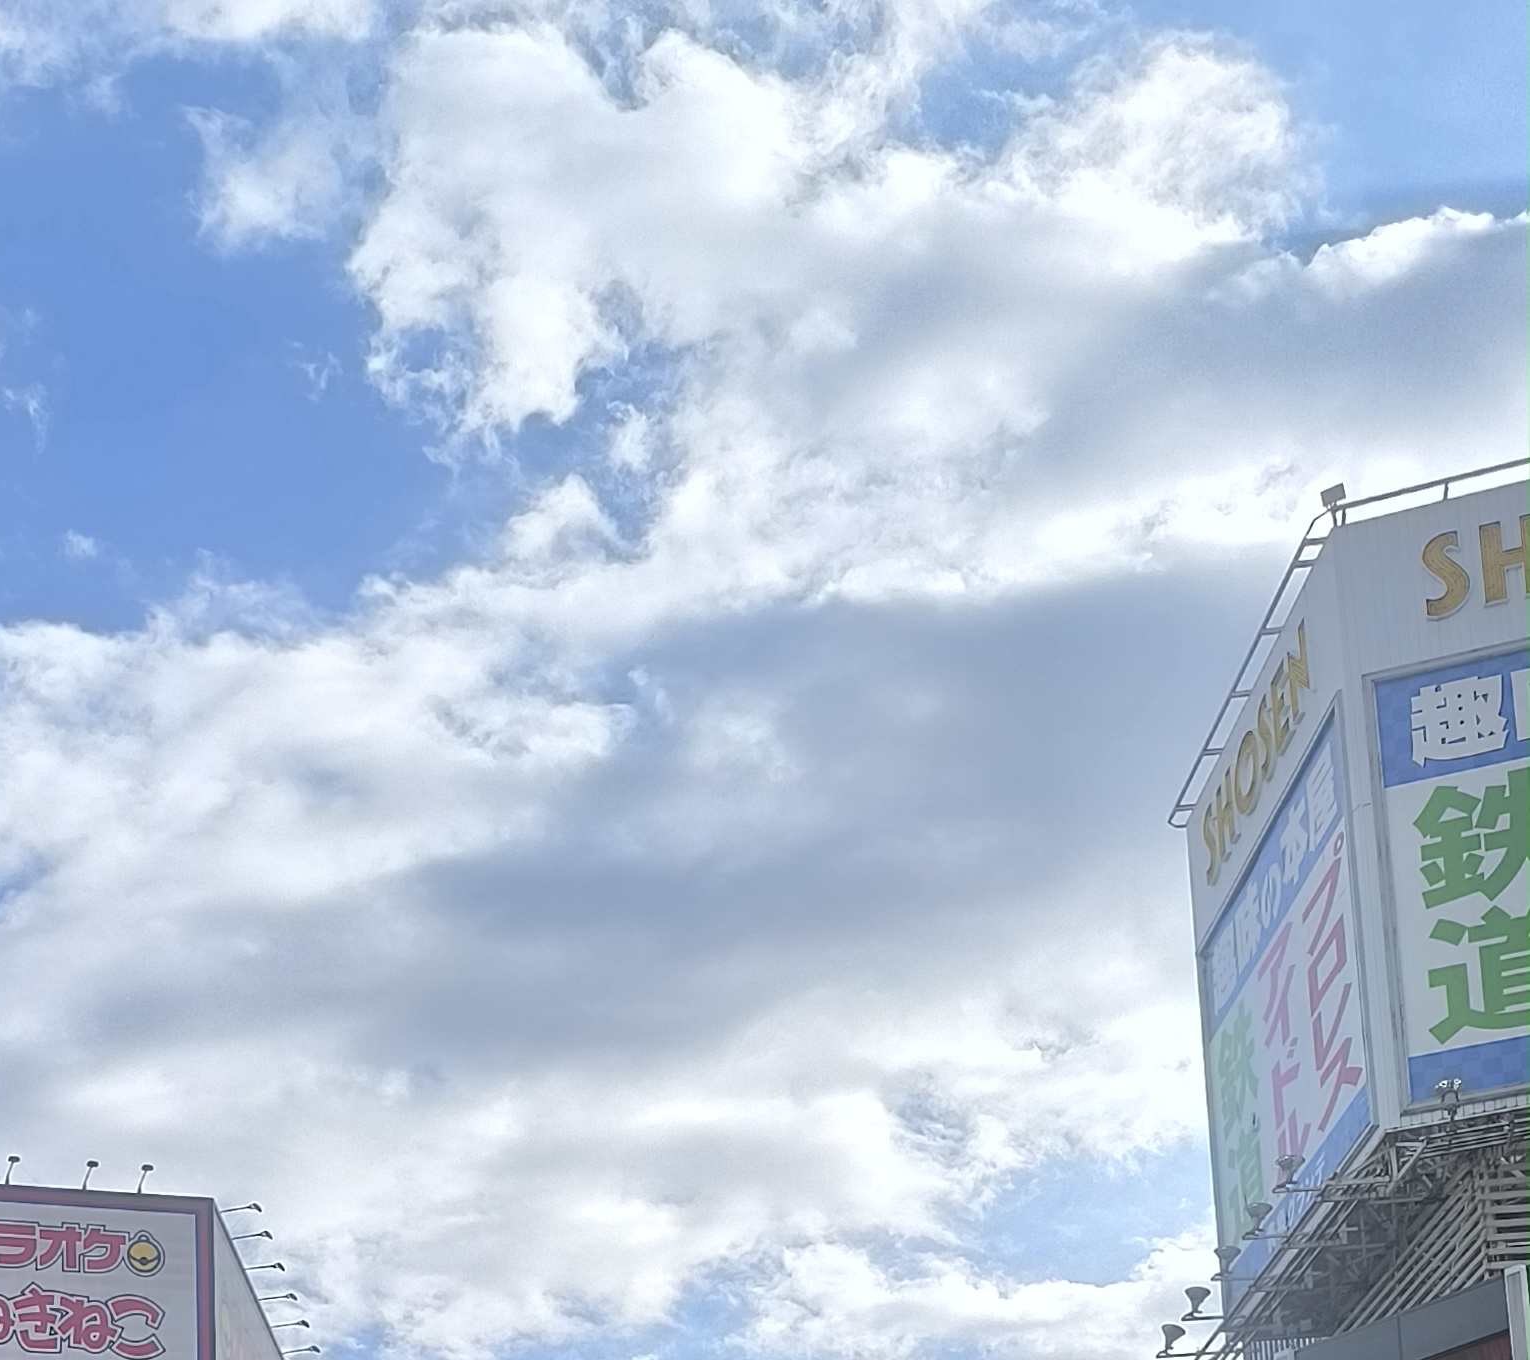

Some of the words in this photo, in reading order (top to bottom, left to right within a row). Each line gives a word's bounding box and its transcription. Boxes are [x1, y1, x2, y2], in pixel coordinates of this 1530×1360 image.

[1422, 514, 1530, 618] SH
[1203, 617, 1312, 887] SHOSEN
[1410, 668, 1530, 768] 趣
[1212, 740, 1340, 1004] 趣味の本屋
[1302, 830, 1363, 1133] プロレス
[1215, 997, 1264, 1238] 鉄道
[1256, 920, 1312, 1192] アイドル
